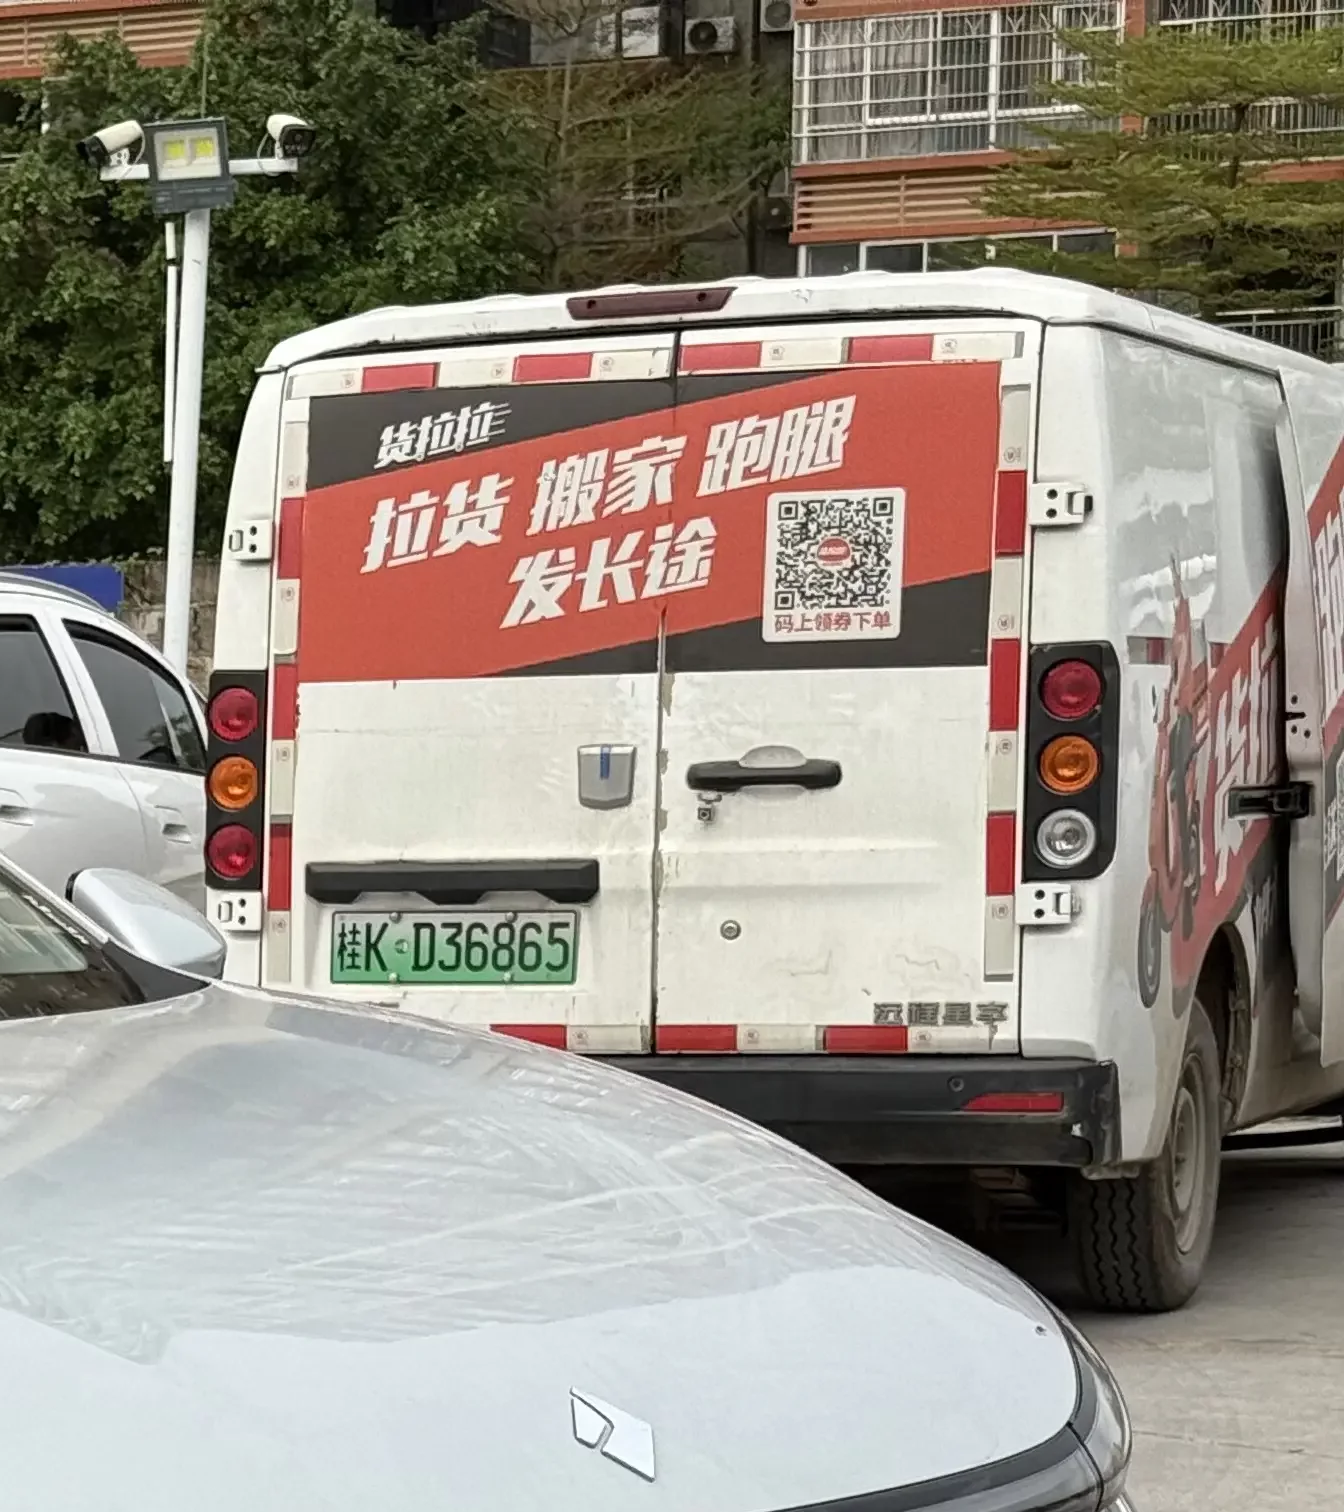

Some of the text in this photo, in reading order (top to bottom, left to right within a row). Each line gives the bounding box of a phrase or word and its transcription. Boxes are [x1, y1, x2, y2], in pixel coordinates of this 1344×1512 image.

[373, 401, 512, 469] 货拉拉
[360, 395, 857, 574] 拉货 搬家 跑腿
[500, 515, 718, 629] 发长途
[774, 610, 892, 634] 码上领券下单
